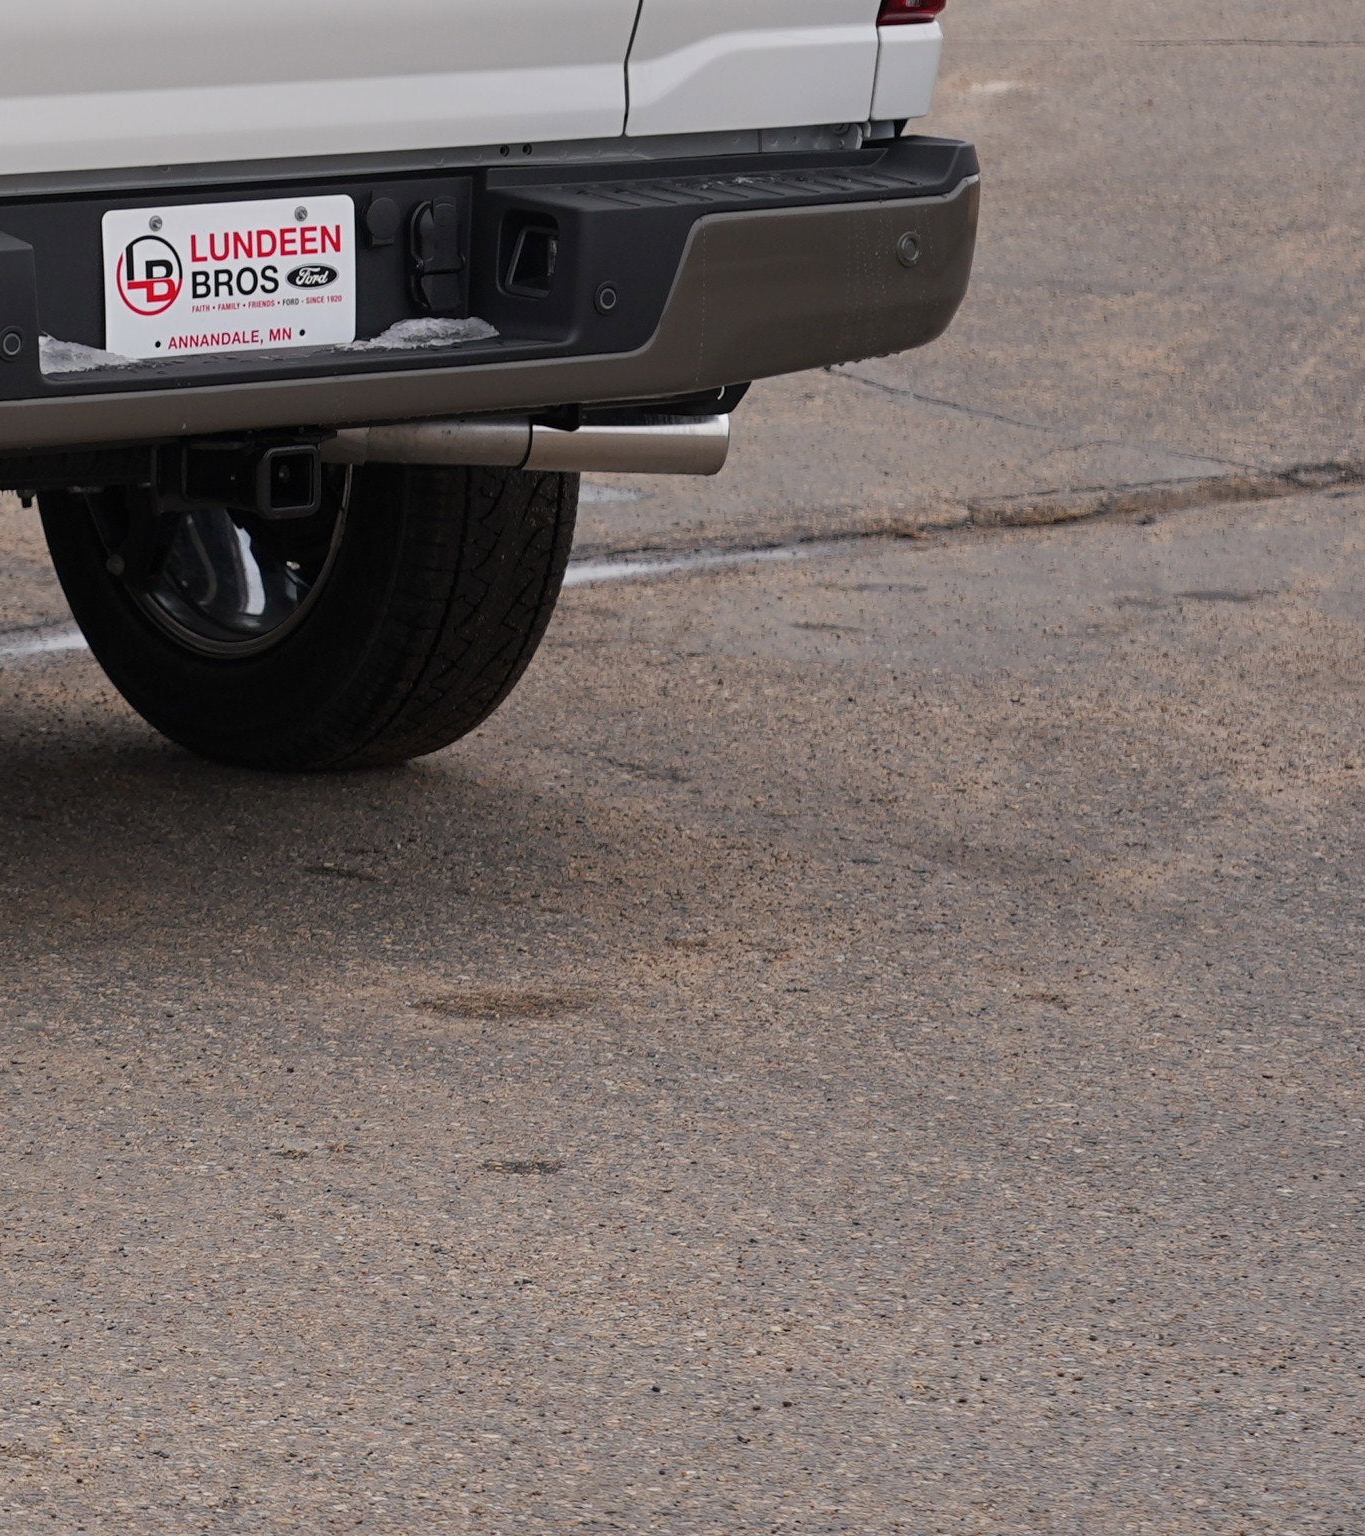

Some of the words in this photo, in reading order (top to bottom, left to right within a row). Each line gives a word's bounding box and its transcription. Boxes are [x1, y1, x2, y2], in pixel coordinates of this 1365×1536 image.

[190, 224, 342, 263] LUNDEEN
[191, 265, 279, 299] BROS
[295, 266, 329, 285] Ford
[192, 305, 210, 313] FAITH
[218, 303, 240, 311] FAMILY
[248, 300, 275, 309] FRIENDS
[282, 298, 299, 306] FORD
[305, 295, 324, 305] SINCE
[327, 295, 343, 303] 1920
[168, 329, 263, 349] ANNANDALE,
[269, 328, 292, 342] MN
